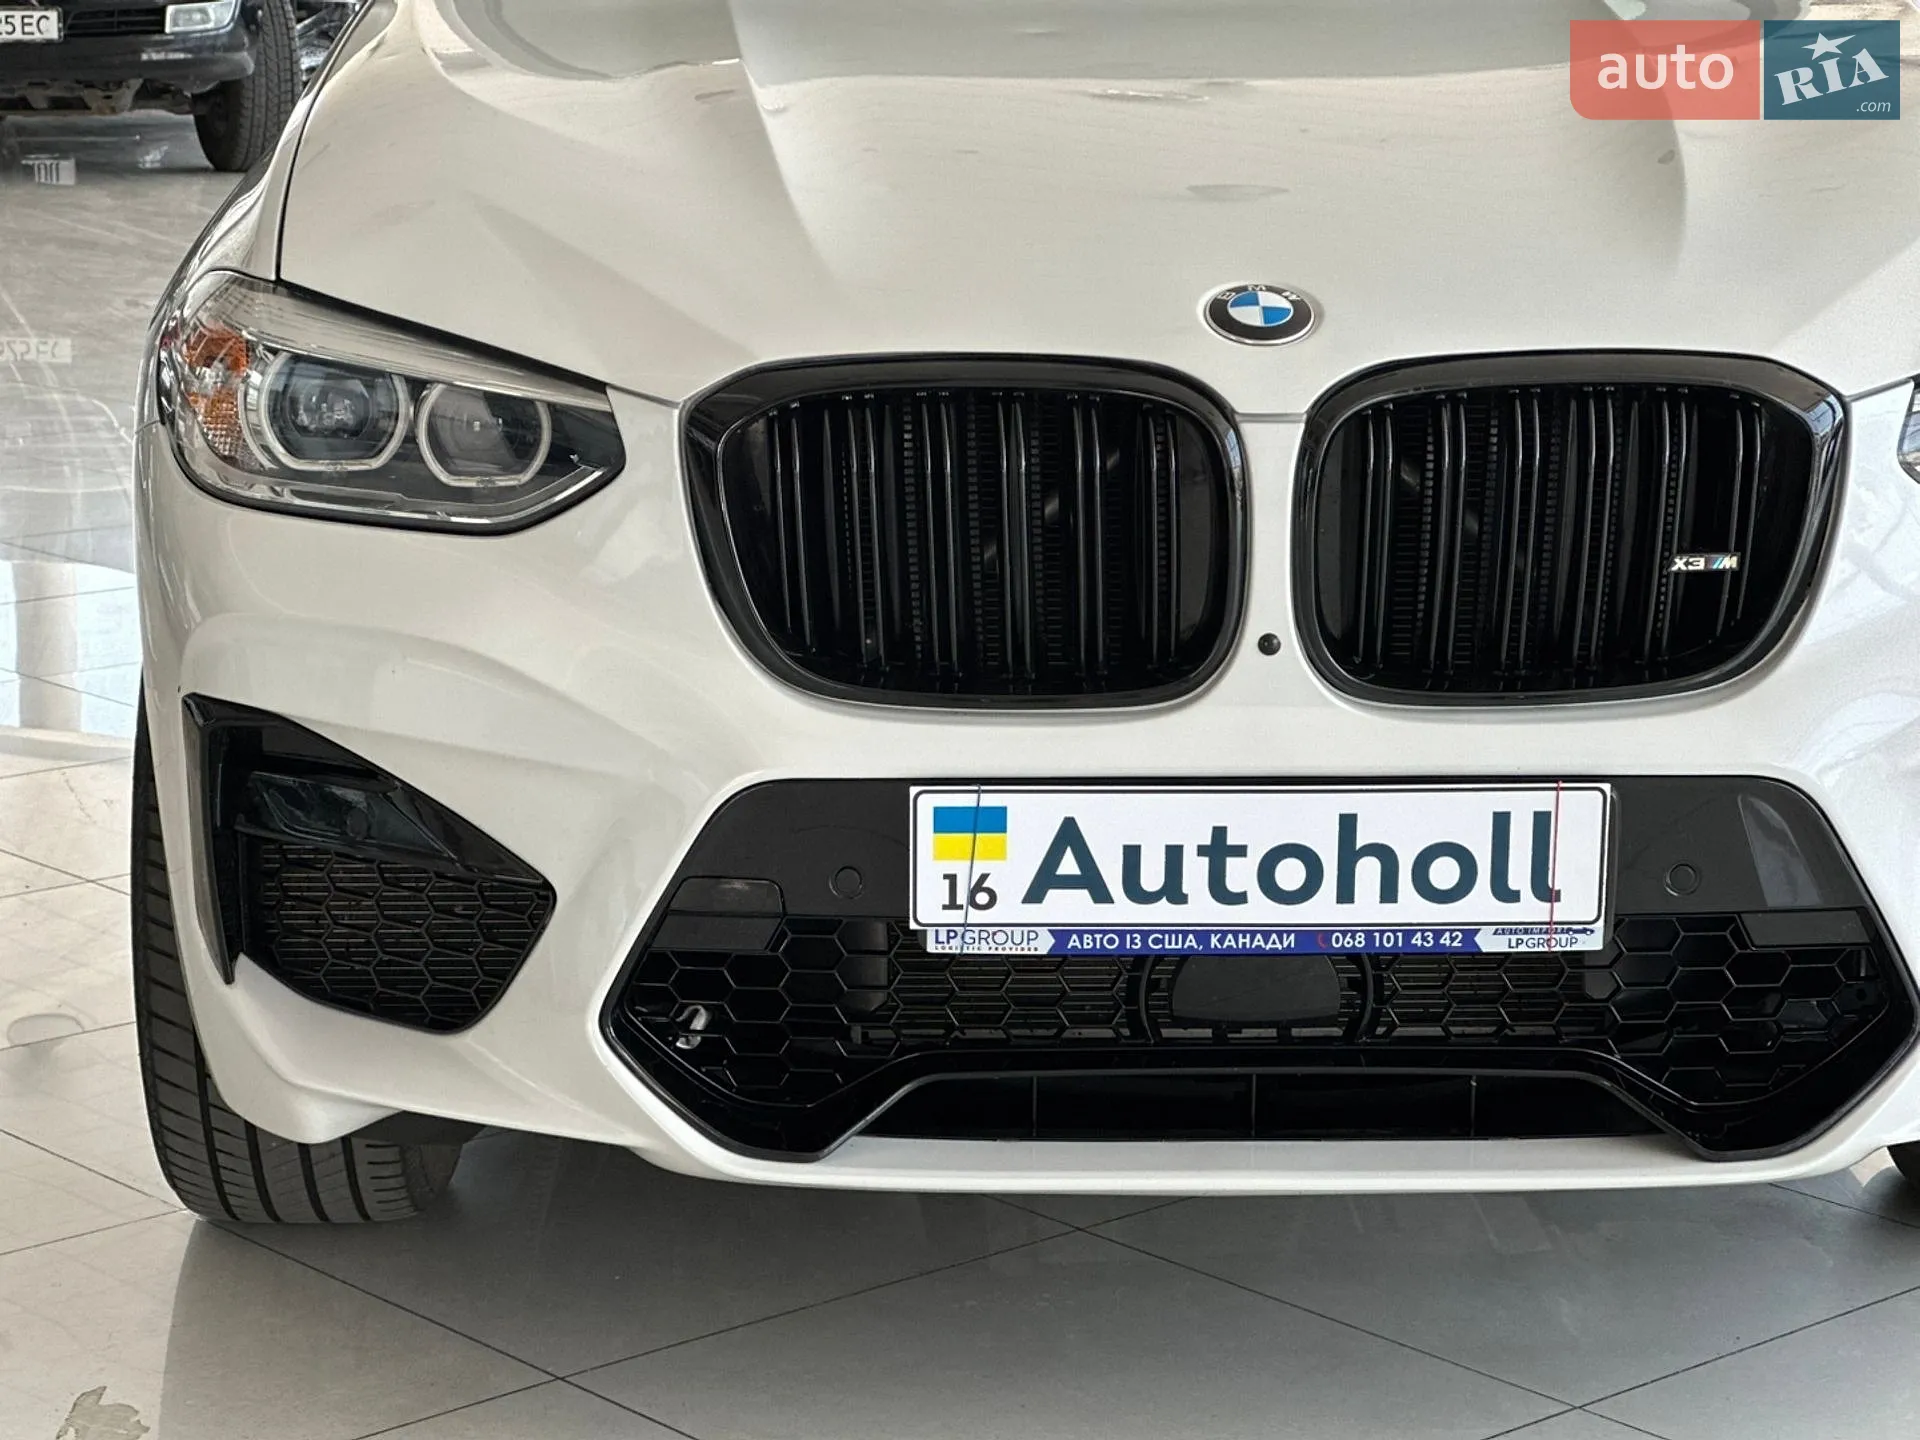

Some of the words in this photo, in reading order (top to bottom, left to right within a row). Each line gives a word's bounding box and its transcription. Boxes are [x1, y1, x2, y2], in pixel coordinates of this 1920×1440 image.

[1671, 556, 1705, 571] X3
[1021, 811, 1562, 906] Autoholl
[941, 873, 998, 911] 16
[1067, 933, 1119, 949] АВТО
[1148, 933, 1203, 950] США,
[1210, 933, 1295, 950] КАНАДИ
[1331, 932, 1366, 948] 068
[1374, 932, 1402, 947] 101
[1411, 931, 1434, 947] 43
[1439, 931, 1463, 947] 42
